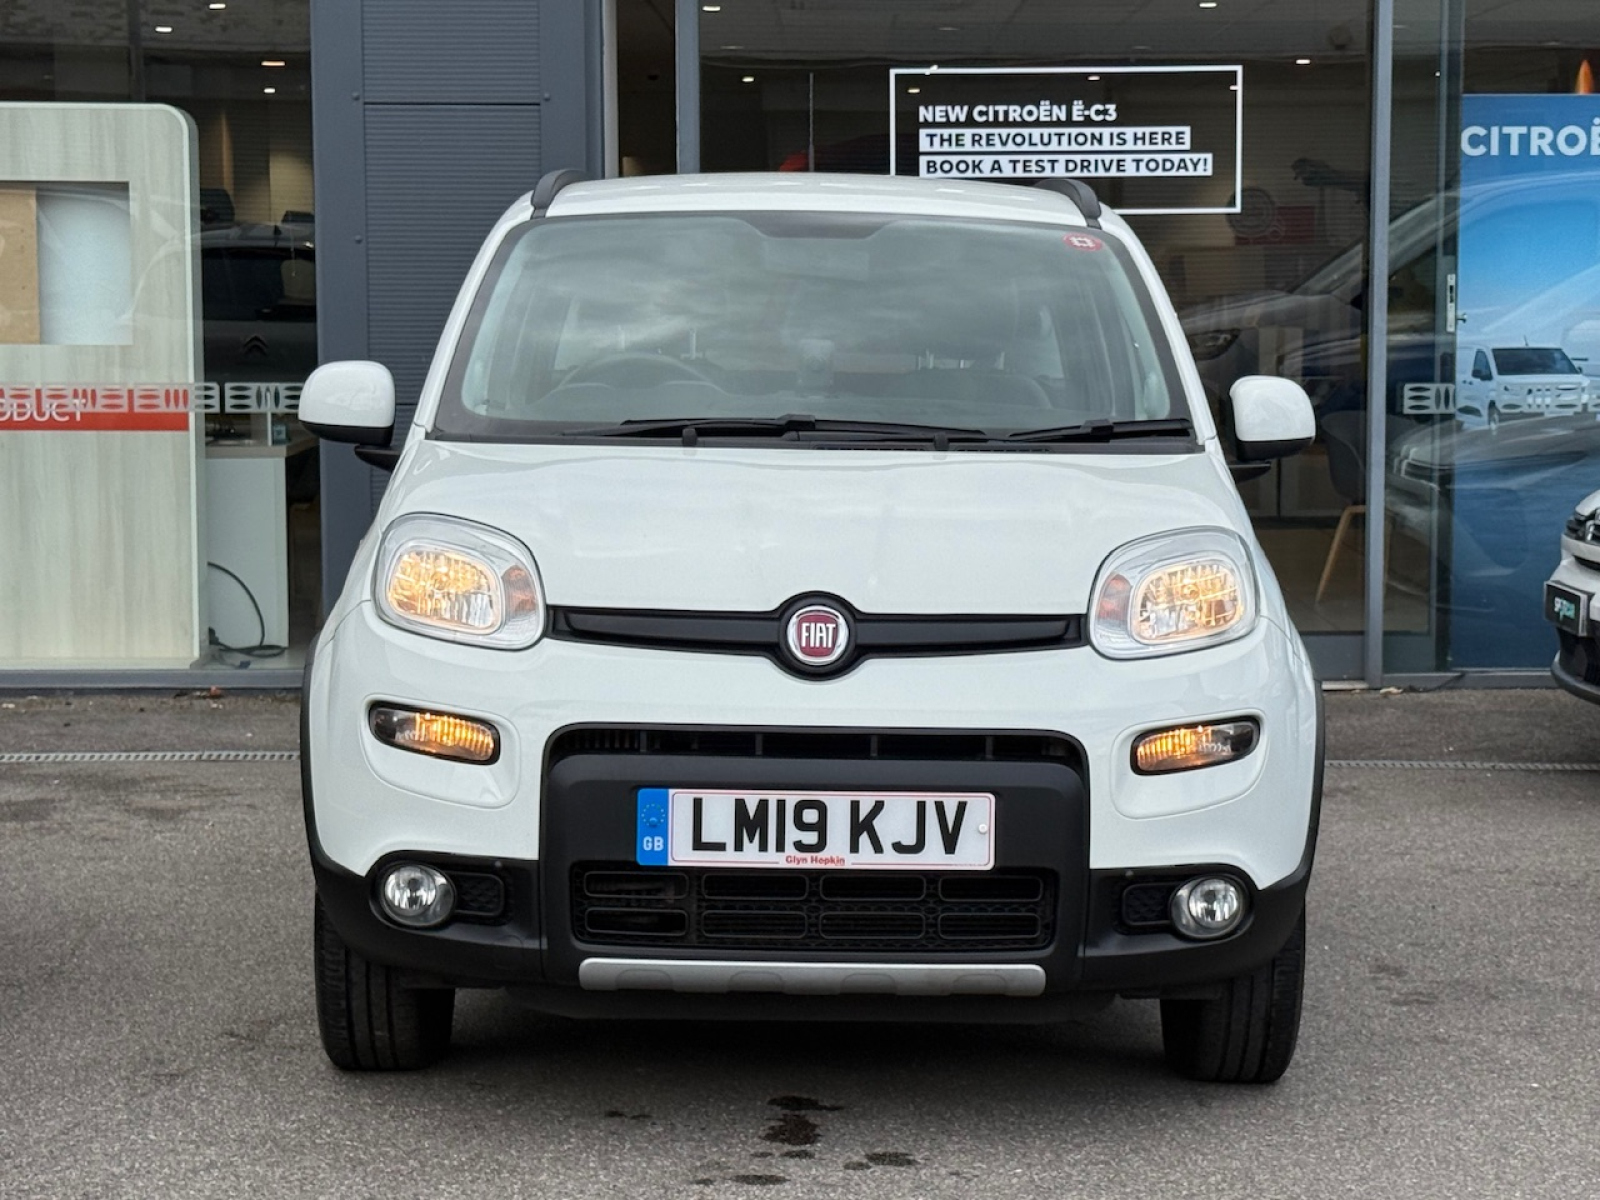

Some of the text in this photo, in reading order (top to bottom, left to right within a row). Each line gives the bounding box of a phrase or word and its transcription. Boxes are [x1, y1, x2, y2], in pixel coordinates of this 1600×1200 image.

[919, 100, 1117, 122] NEW CITROËN Ë-C3
[926, 130, 1186, 148] THE REVOLUTION IS HERE
[926, 157, 1209, 174] BOOK A TEST DRIVE TODAY!
[801, 622, 836, 648] FIAT
[692, 797, 968, 855] LM19 KJV
[643, 836, 664, 851] GB
[785, 855, 808, 865] Glyn
